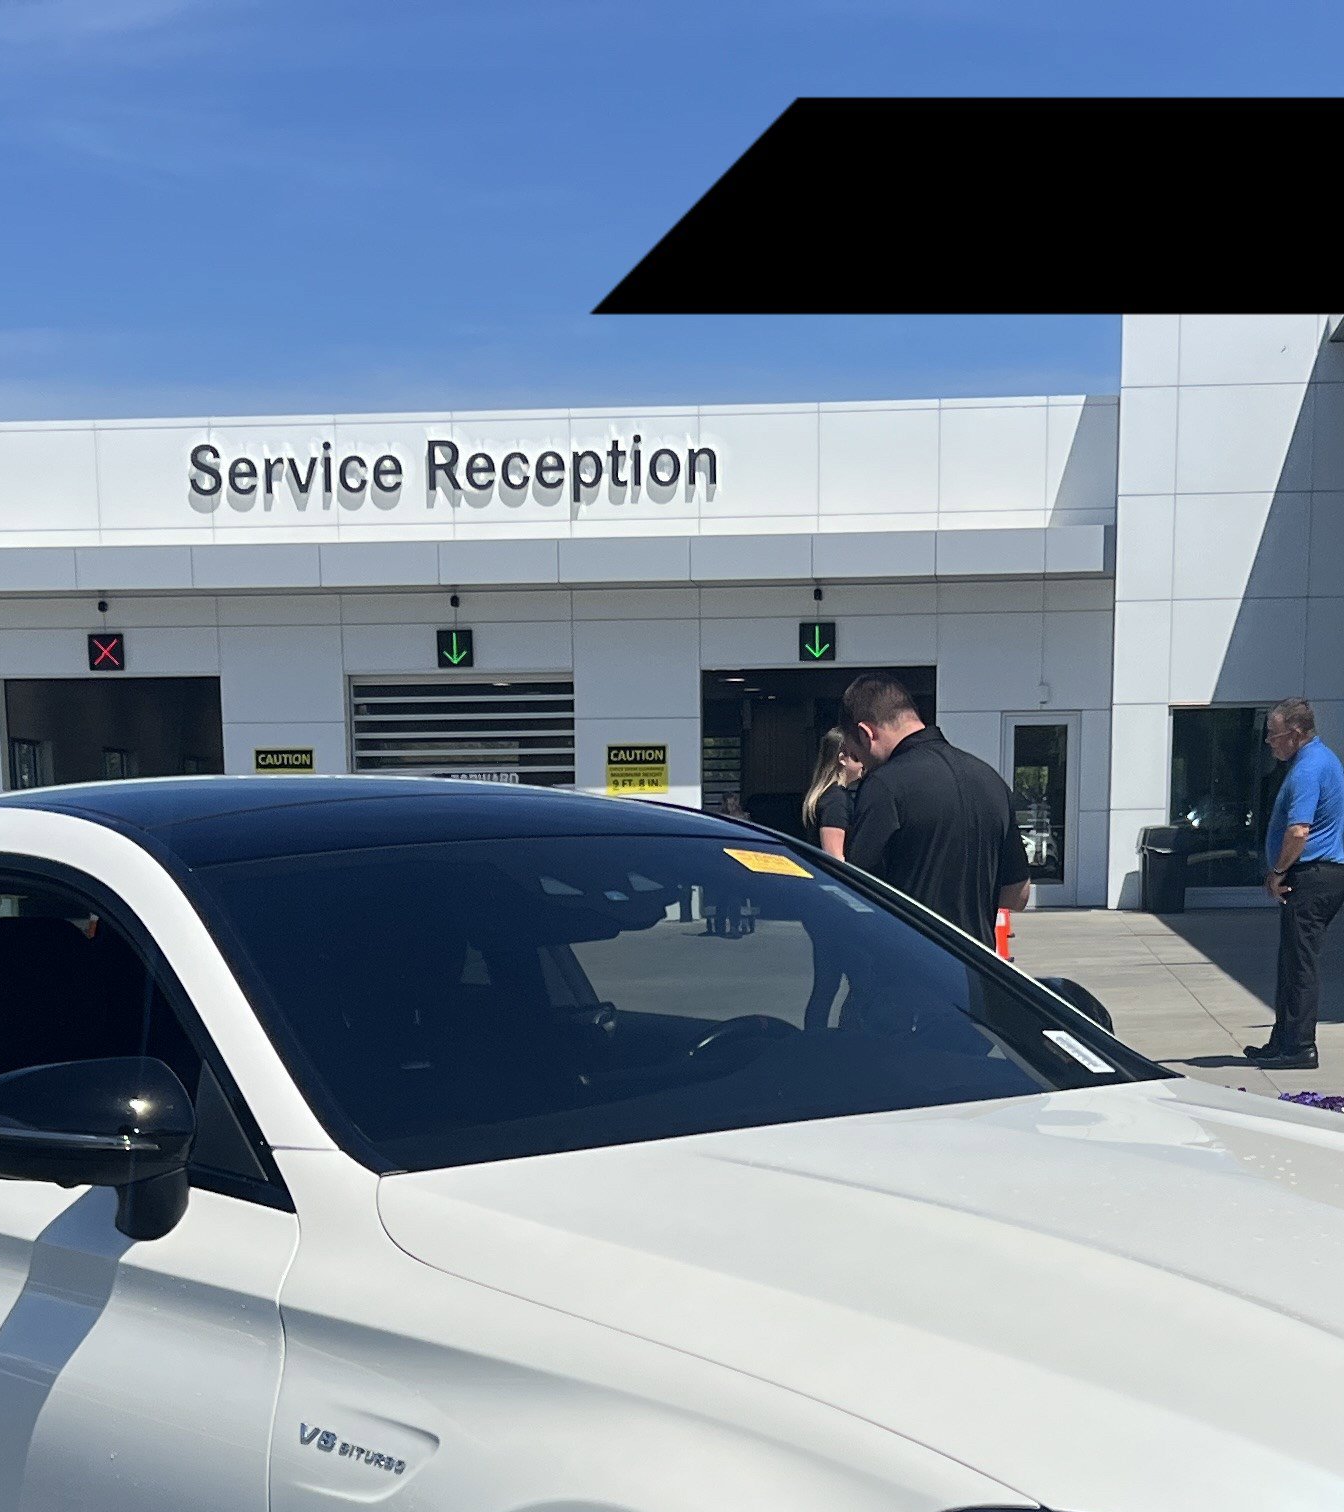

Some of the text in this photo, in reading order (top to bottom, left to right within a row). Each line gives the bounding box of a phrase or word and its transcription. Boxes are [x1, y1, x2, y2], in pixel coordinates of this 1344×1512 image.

[189, 434, 717, 503] Service Reception
[258, 753, 311, 765] CAUTION
[610, 749, 664, 761] CAUTION
[300, 1422, 407, 1475] V8 BITURBO
